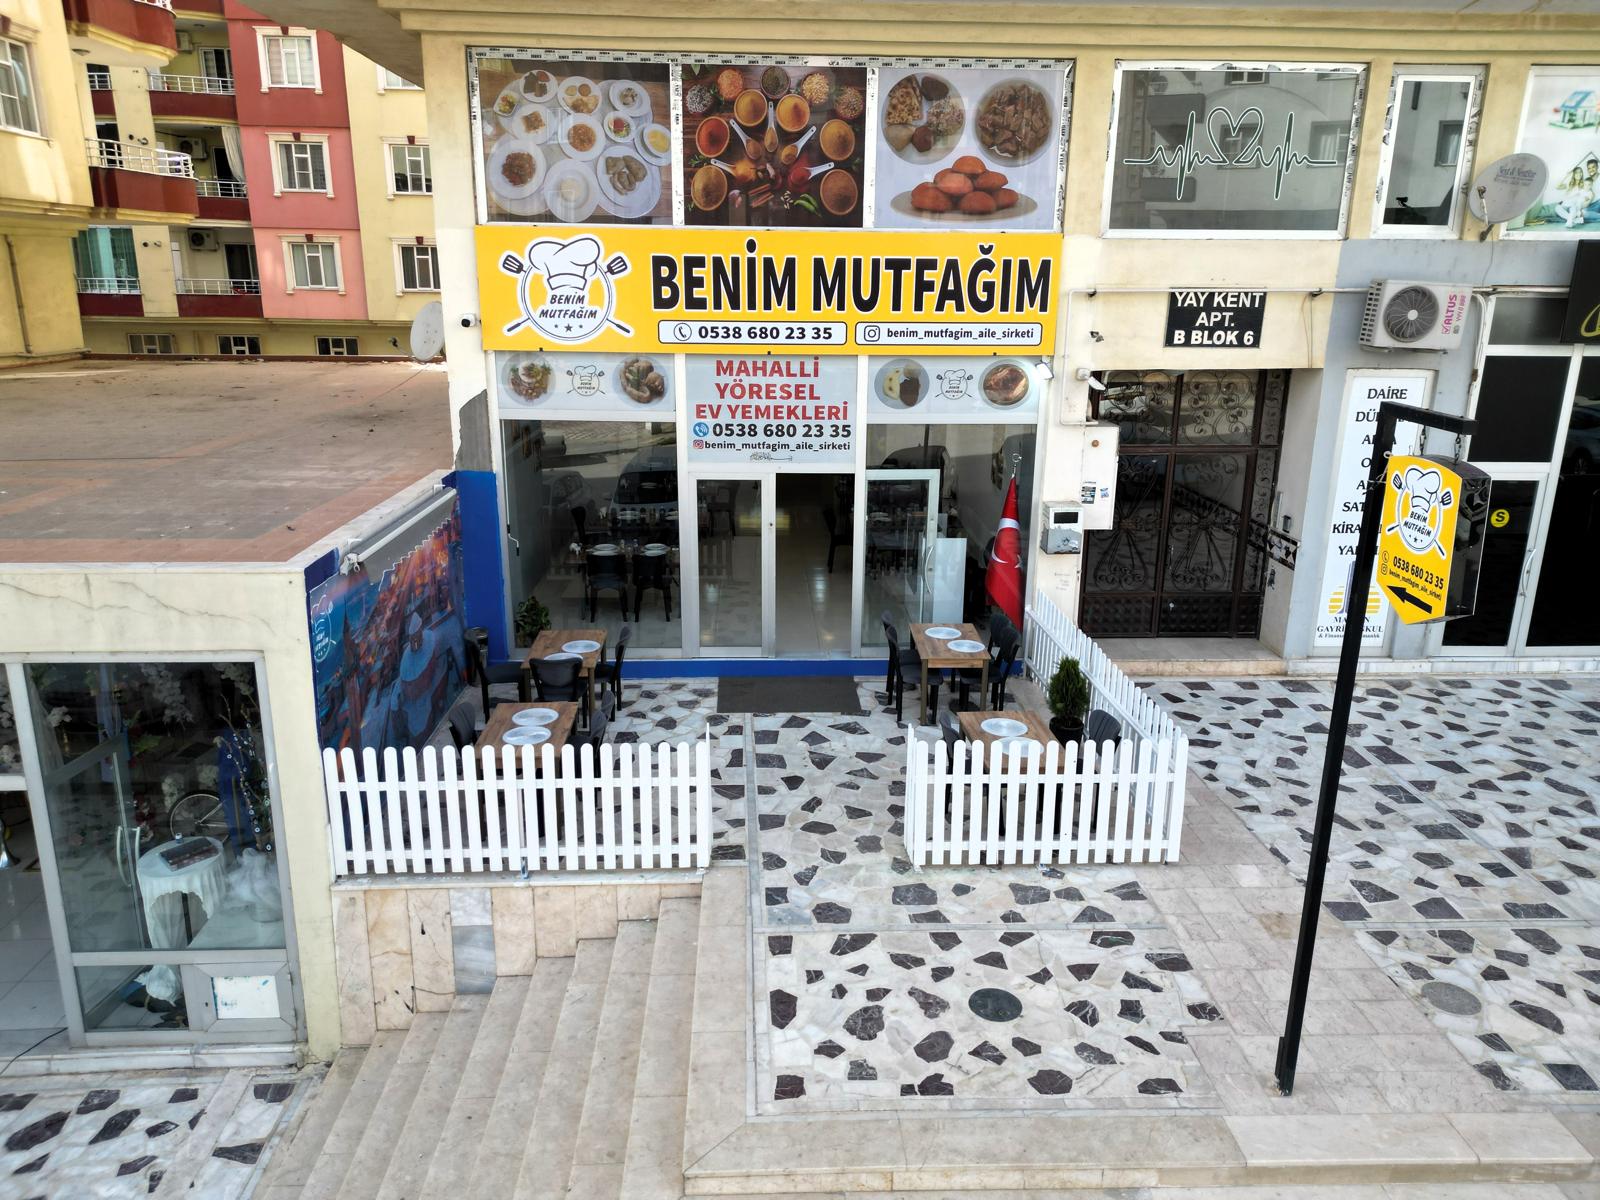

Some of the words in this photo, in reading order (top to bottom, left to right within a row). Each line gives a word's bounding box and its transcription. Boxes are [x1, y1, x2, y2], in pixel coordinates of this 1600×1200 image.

[652, 239, 796, 312] BENİM
[812, 244, 1051, 313] MUTFAĞIM
[549, 292, 585, 305] BENİM
[1174, 291, 1210, 307] YAY
[1213, 292, 1264, 308] KENT
[538, 307, 598, 319] MUTFAĞIM
[1443, 294, 1458, 325] ALTUS
[1194, 311, 1236, 327] APT.
[698, 326, 742, 339] 0538
[747, 327, 780, 339] 680
[785, 327, 806, 340] 23
[811, 327, 833, 340] 35
[887, 327, 1034, 340] benim_mutfagim_aile_sirketi
[1173, 330, 1186, 344] B
[1190, 330, 1239, 345] BLOK
[1243, 331, 1254, 345] 6
[715, 356, 820, 378] MAHALLİ
[714, 378, 821, 400] YÖRESEL
[1367, 386, 1408, 400] DAİRE
[695, 404, 722, 419] EV
[726, 401, 849, 420] YEMEKLERİ
[712, 423, 758, 437] 0538
[763, 423, 797, 438] 680
[802, 424, 825, 438] 23
[829, 424, 852, 438] 35
[704, 440, 851, 452] benim_mutfagim_aile_sirketi
[1393, 556, 1409, 572] 0538
[1411, 565, 1423, 579] 680
[1425, 571, 1433, 584] 23
[1435, 576, 1444, 589] 35
